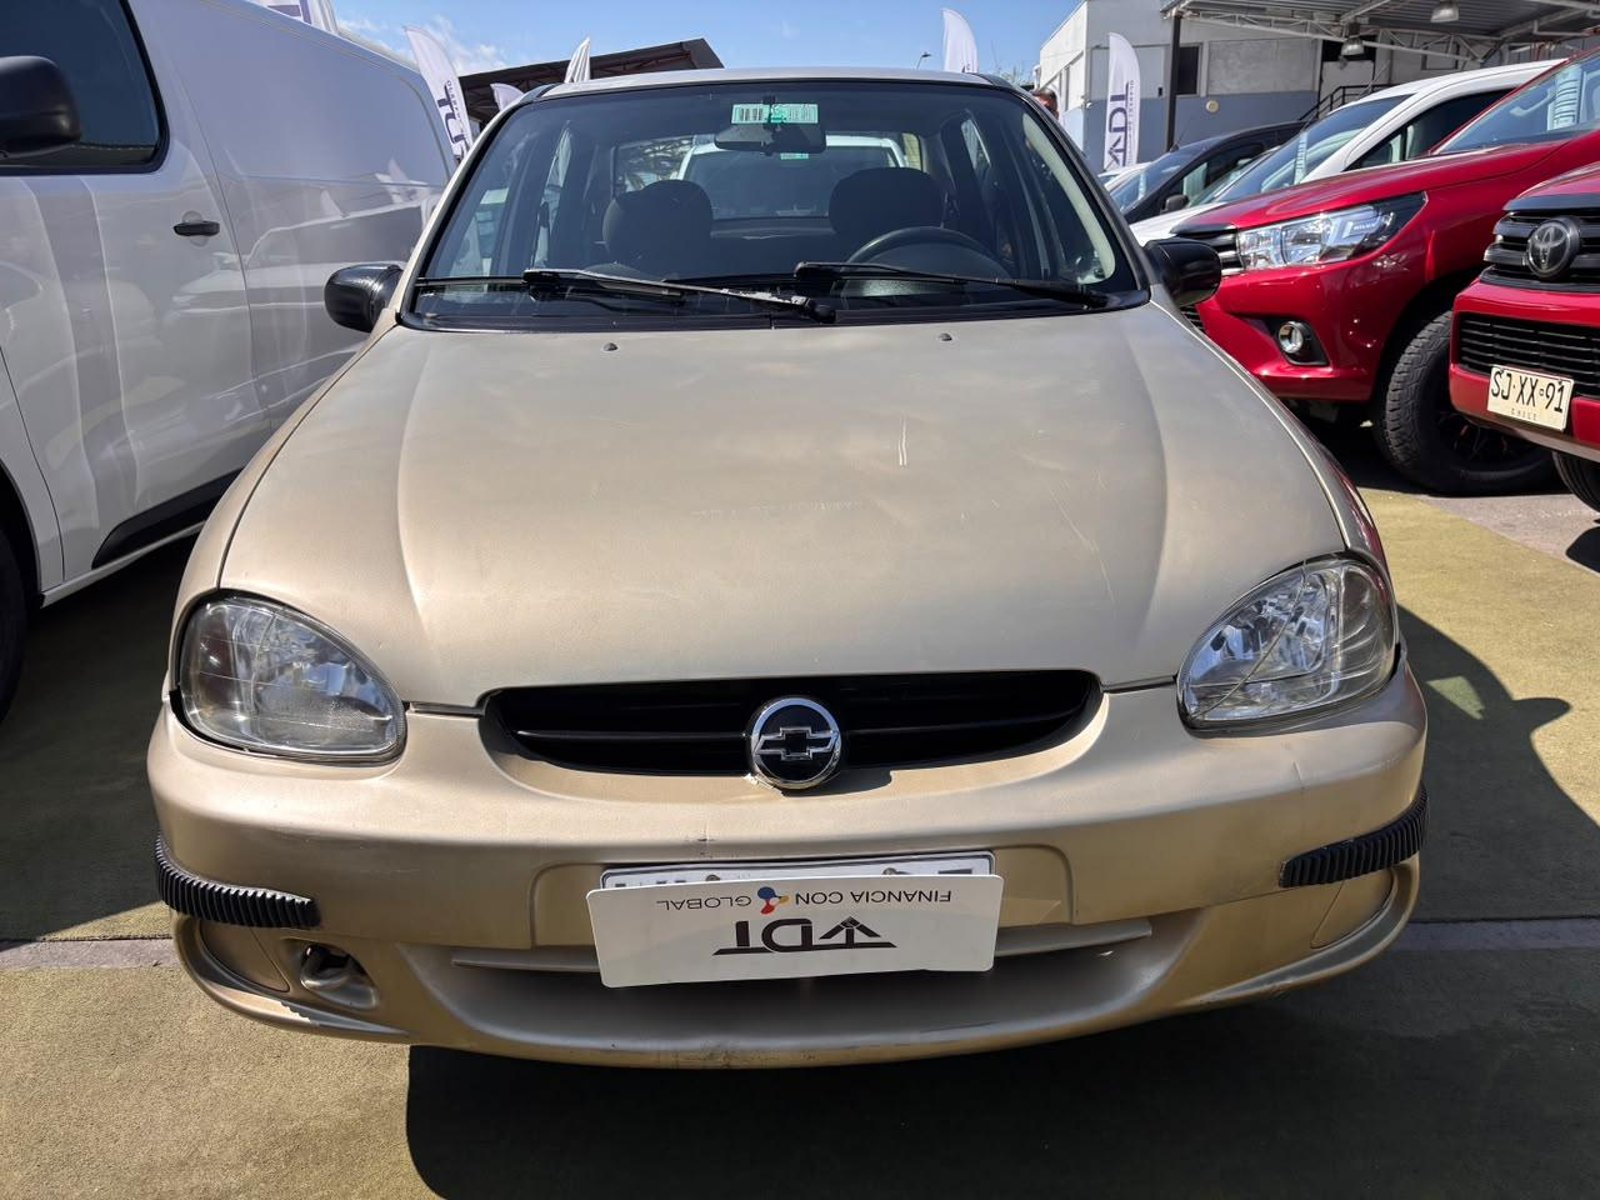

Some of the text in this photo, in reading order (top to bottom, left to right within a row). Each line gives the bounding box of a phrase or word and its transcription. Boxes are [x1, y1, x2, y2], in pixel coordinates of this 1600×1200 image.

[656, 889, 952, 911] FINANCIA CON GLOBAL
